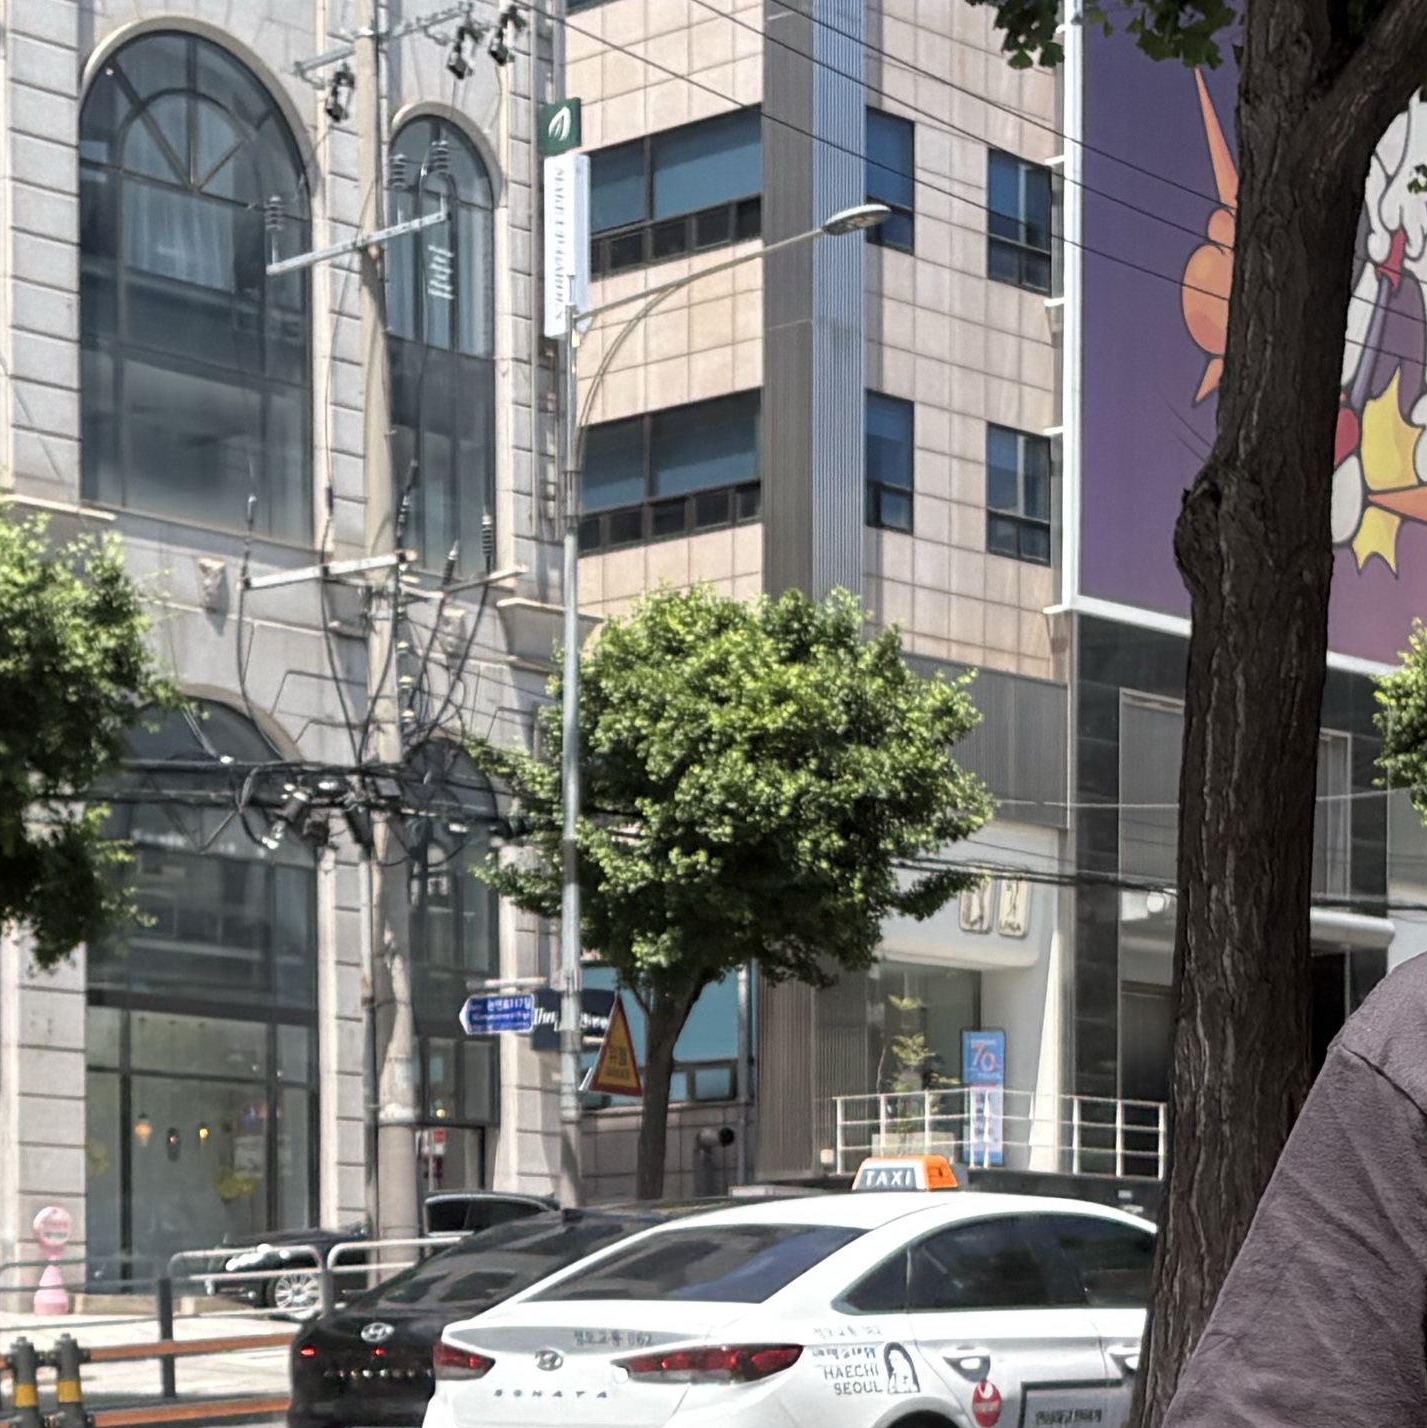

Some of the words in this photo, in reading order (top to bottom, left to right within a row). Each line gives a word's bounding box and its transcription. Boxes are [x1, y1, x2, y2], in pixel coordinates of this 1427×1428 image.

[866, 1169, 912, 1187] TAXI
[823, 1363, 880, 1380] HAECHI
[833, 1380, 884, 1396] SEOUL
